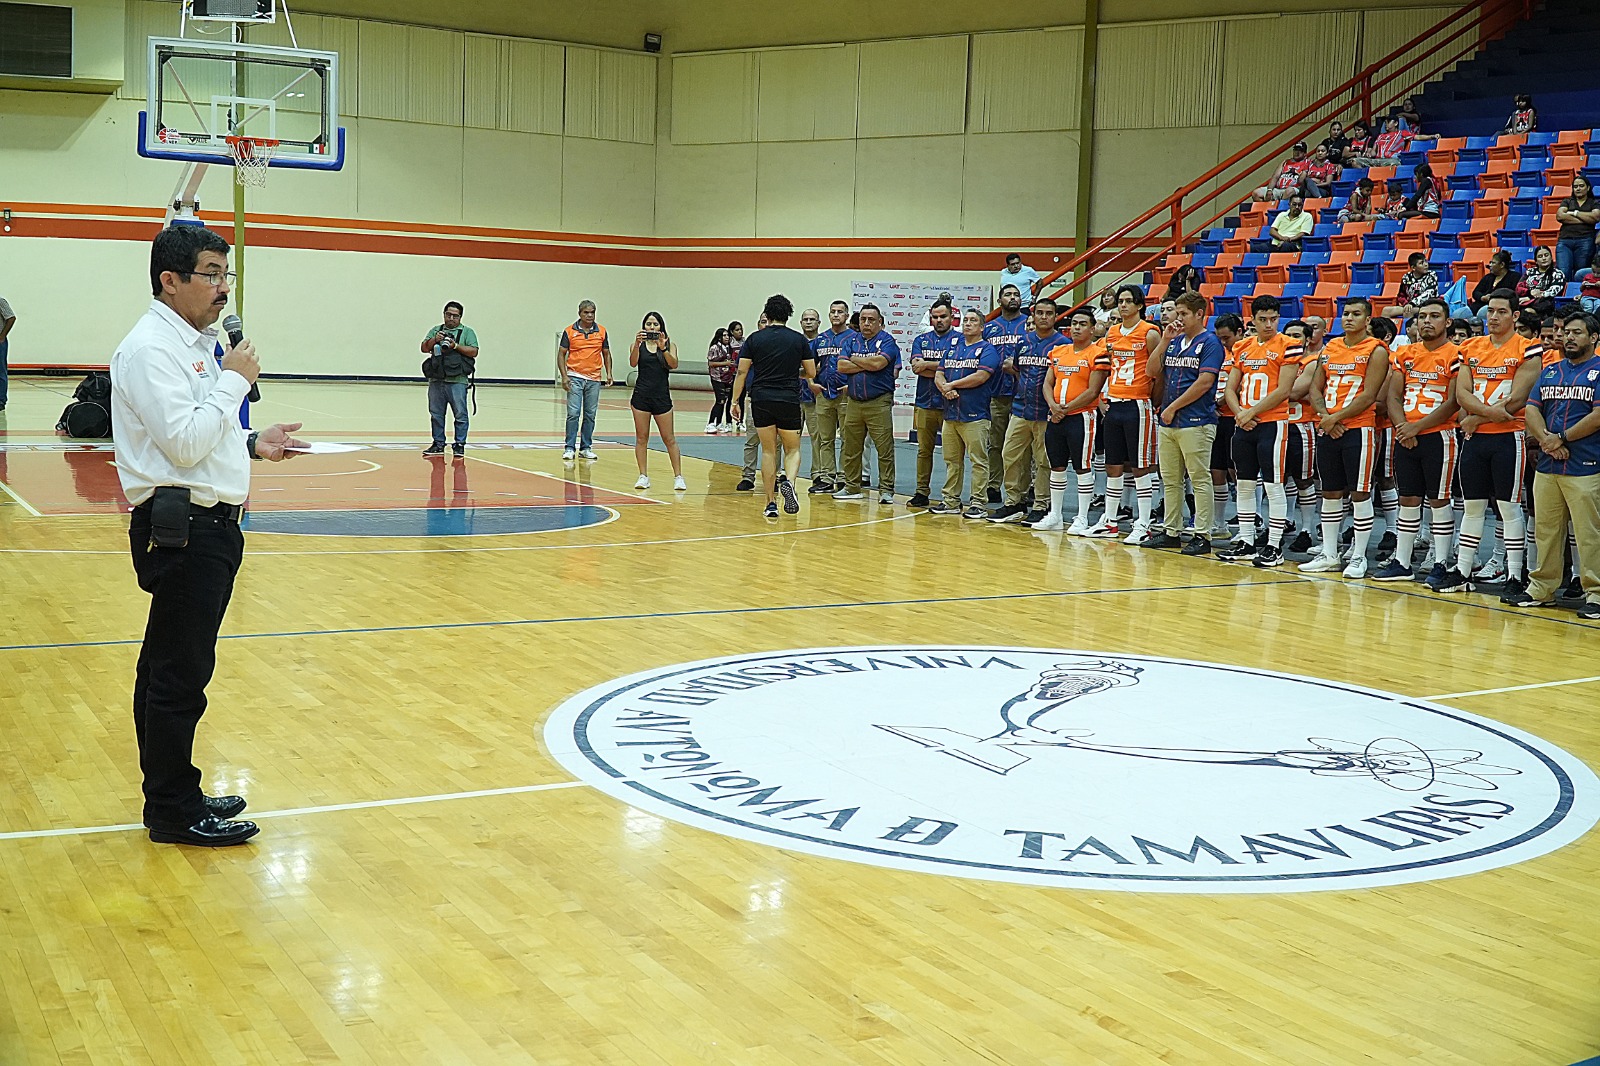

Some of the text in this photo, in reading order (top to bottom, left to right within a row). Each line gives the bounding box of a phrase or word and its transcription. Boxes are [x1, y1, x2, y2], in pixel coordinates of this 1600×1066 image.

[1111, 358, 1136, 386] 14
[1060, 378, 1070, 405] 1
[1241, 372, 1269, 407] 10
[1325, 374, 1363, 409] 87
[1403, 382, 1447, 415] 85
[1472, 378, 1513, 406] 84
